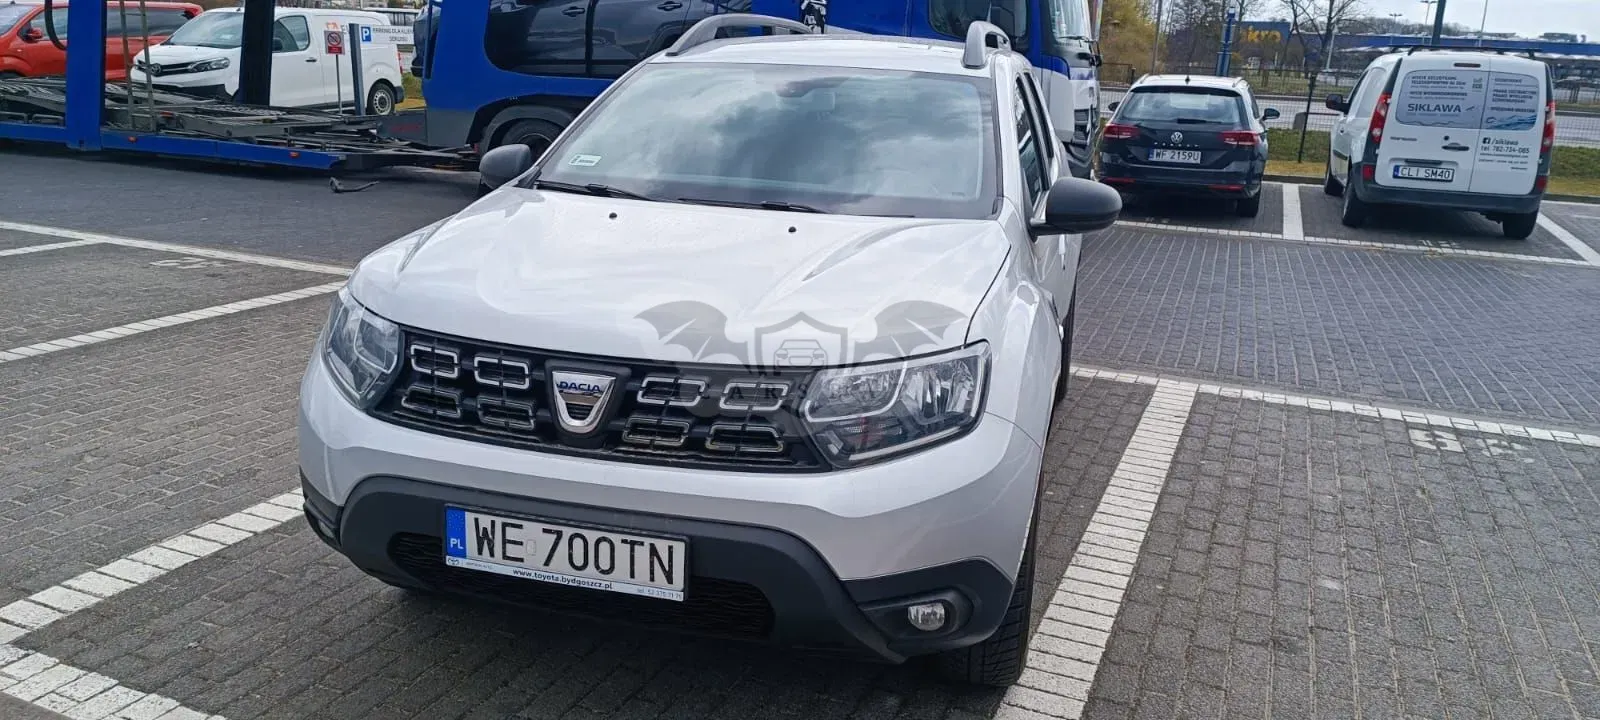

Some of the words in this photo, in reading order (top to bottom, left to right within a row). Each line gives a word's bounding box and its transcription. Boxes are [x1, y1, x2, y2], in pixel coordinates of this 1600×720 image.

[362, 28, 370, 40] P
[1407, 103, 1462, 113] SIKLAWA
[1155, 150, 1167, 158] WF
[1170, 151, 1199, 161] 2159U
[1400, 167, 1420, 177] CLI
[1424, 168, 1451, 179] SM40
[558, 381, 601, 393] DACIA
[450, 538, 464, 549] PL
[473, 517, 525, 563] WE
[541, 527, 675, 586] 700TN
[512, 567, 614, 591] www.toyota.bydgoszcz.pl
